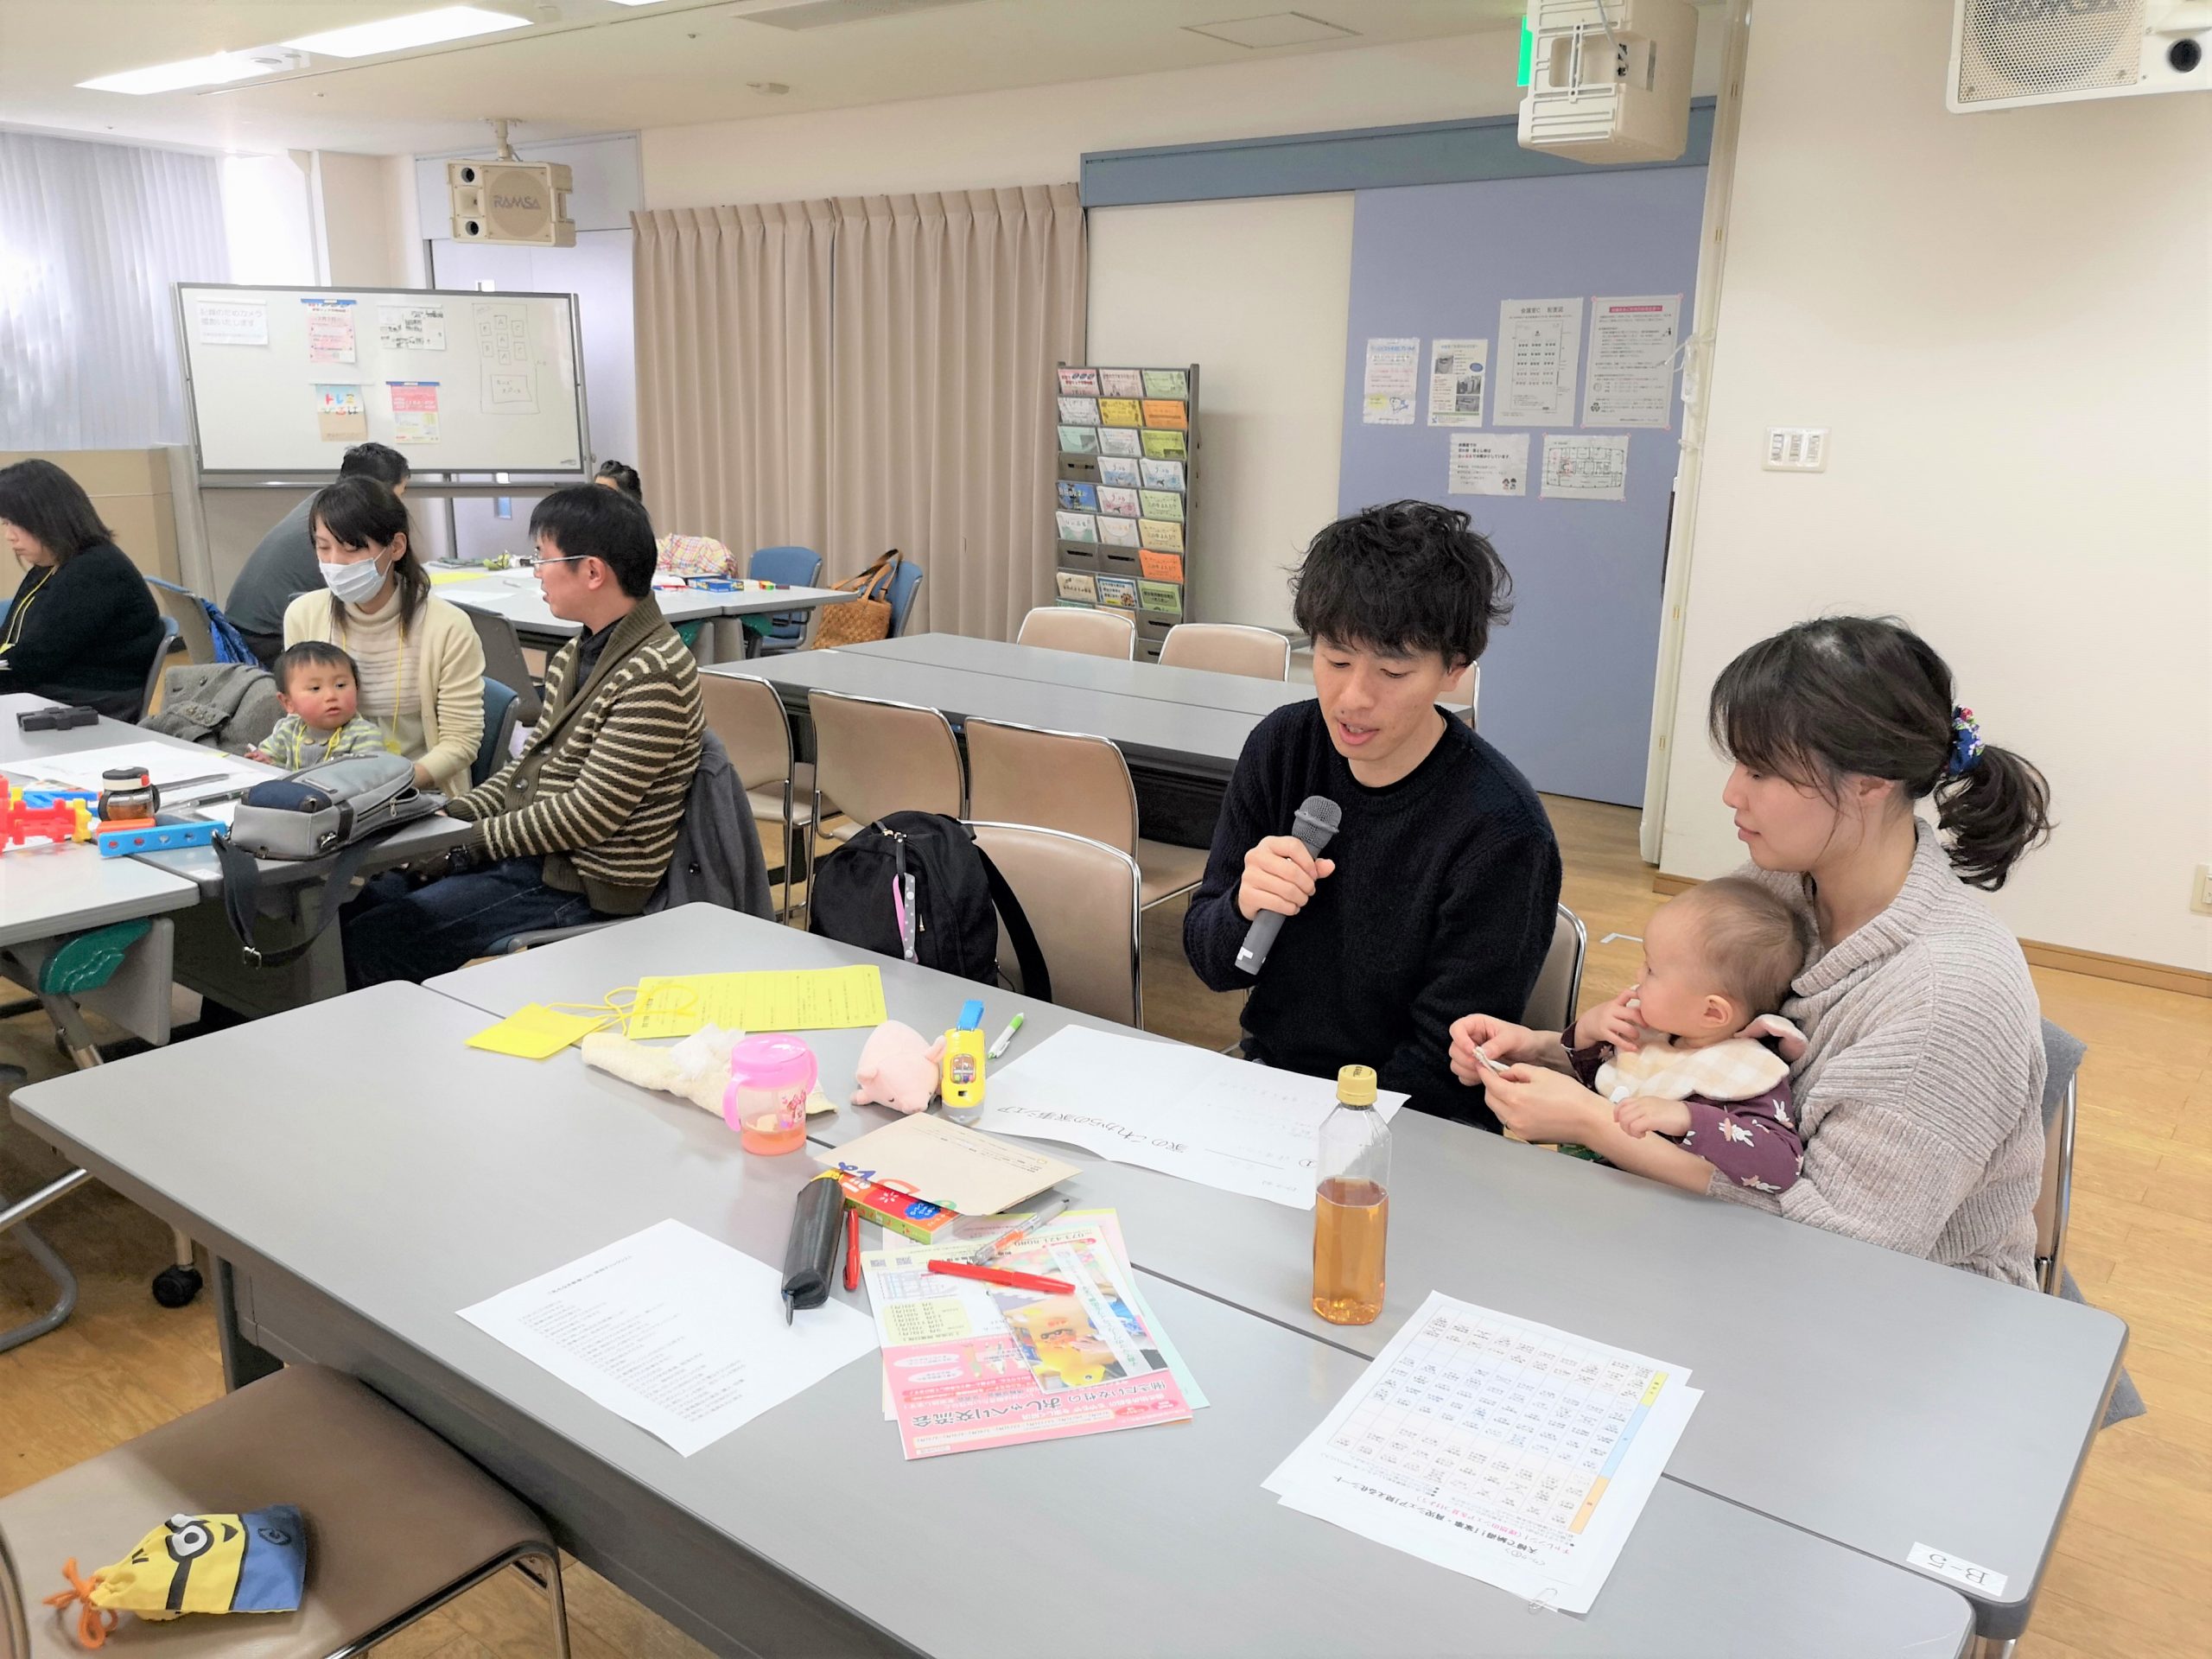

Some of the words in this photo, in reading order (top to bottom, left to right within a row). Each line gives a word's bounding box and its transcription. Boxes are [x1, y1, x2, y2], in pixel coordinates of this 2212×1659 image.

[493, 194, 541, 210] RAMSA
[1065, 1380, 1167, 1403] 働きたい女性の
[910, 1395, 1063, 1429] おしゃべり交流会
[1927, 1553, 1991, 1586] B-5
